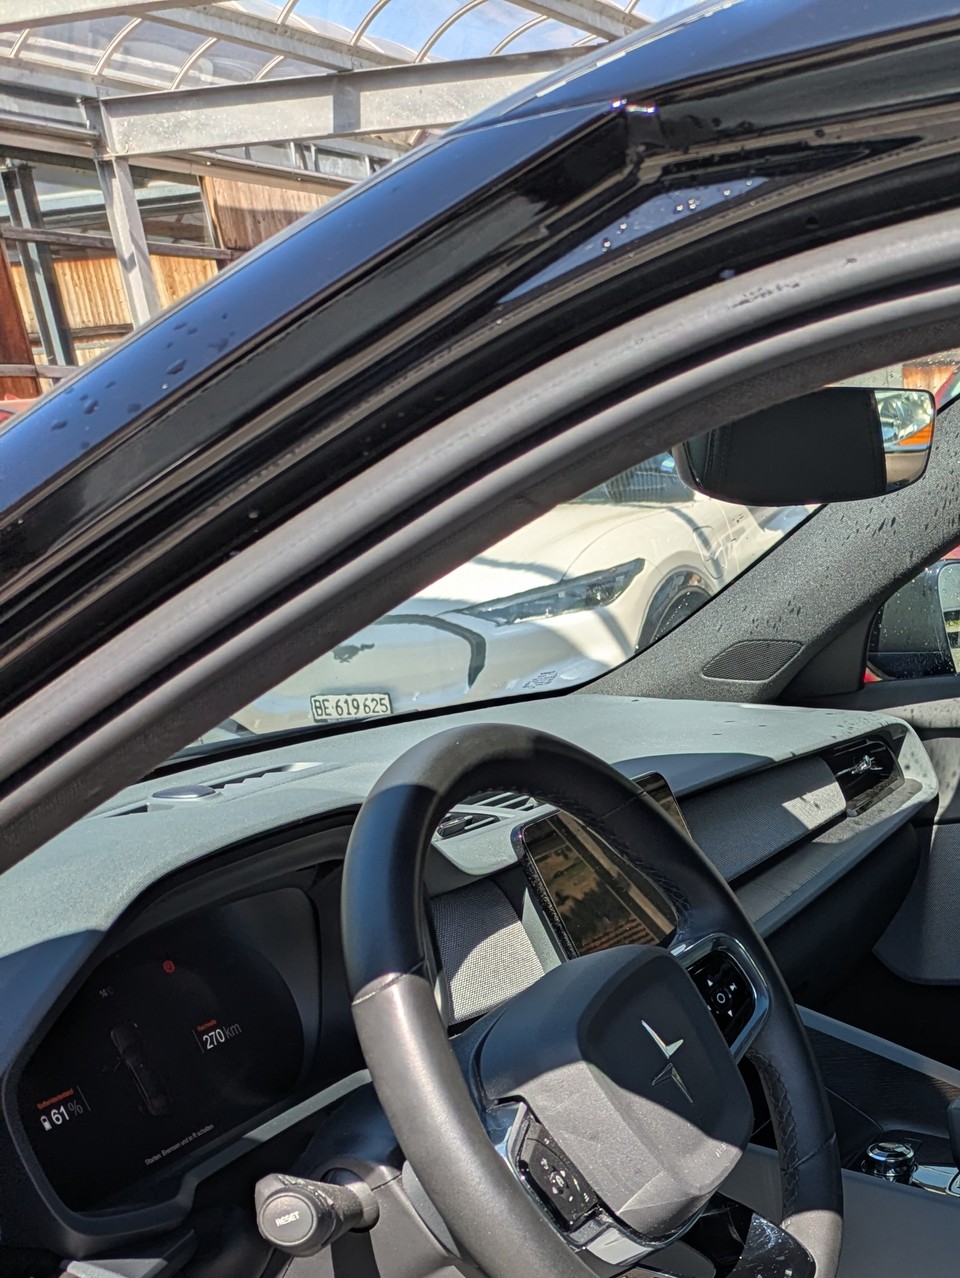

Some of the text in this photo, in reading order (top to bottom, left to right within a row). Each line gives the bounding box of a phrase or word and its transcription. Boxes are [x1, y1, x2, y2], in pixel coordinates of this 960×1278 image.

[363, 697, 389, 714] 625
[202, 1028, 226, 1050] 270
[222, 1023, 243, 1039] km
[275, 1210, 300, 1227] RESET
